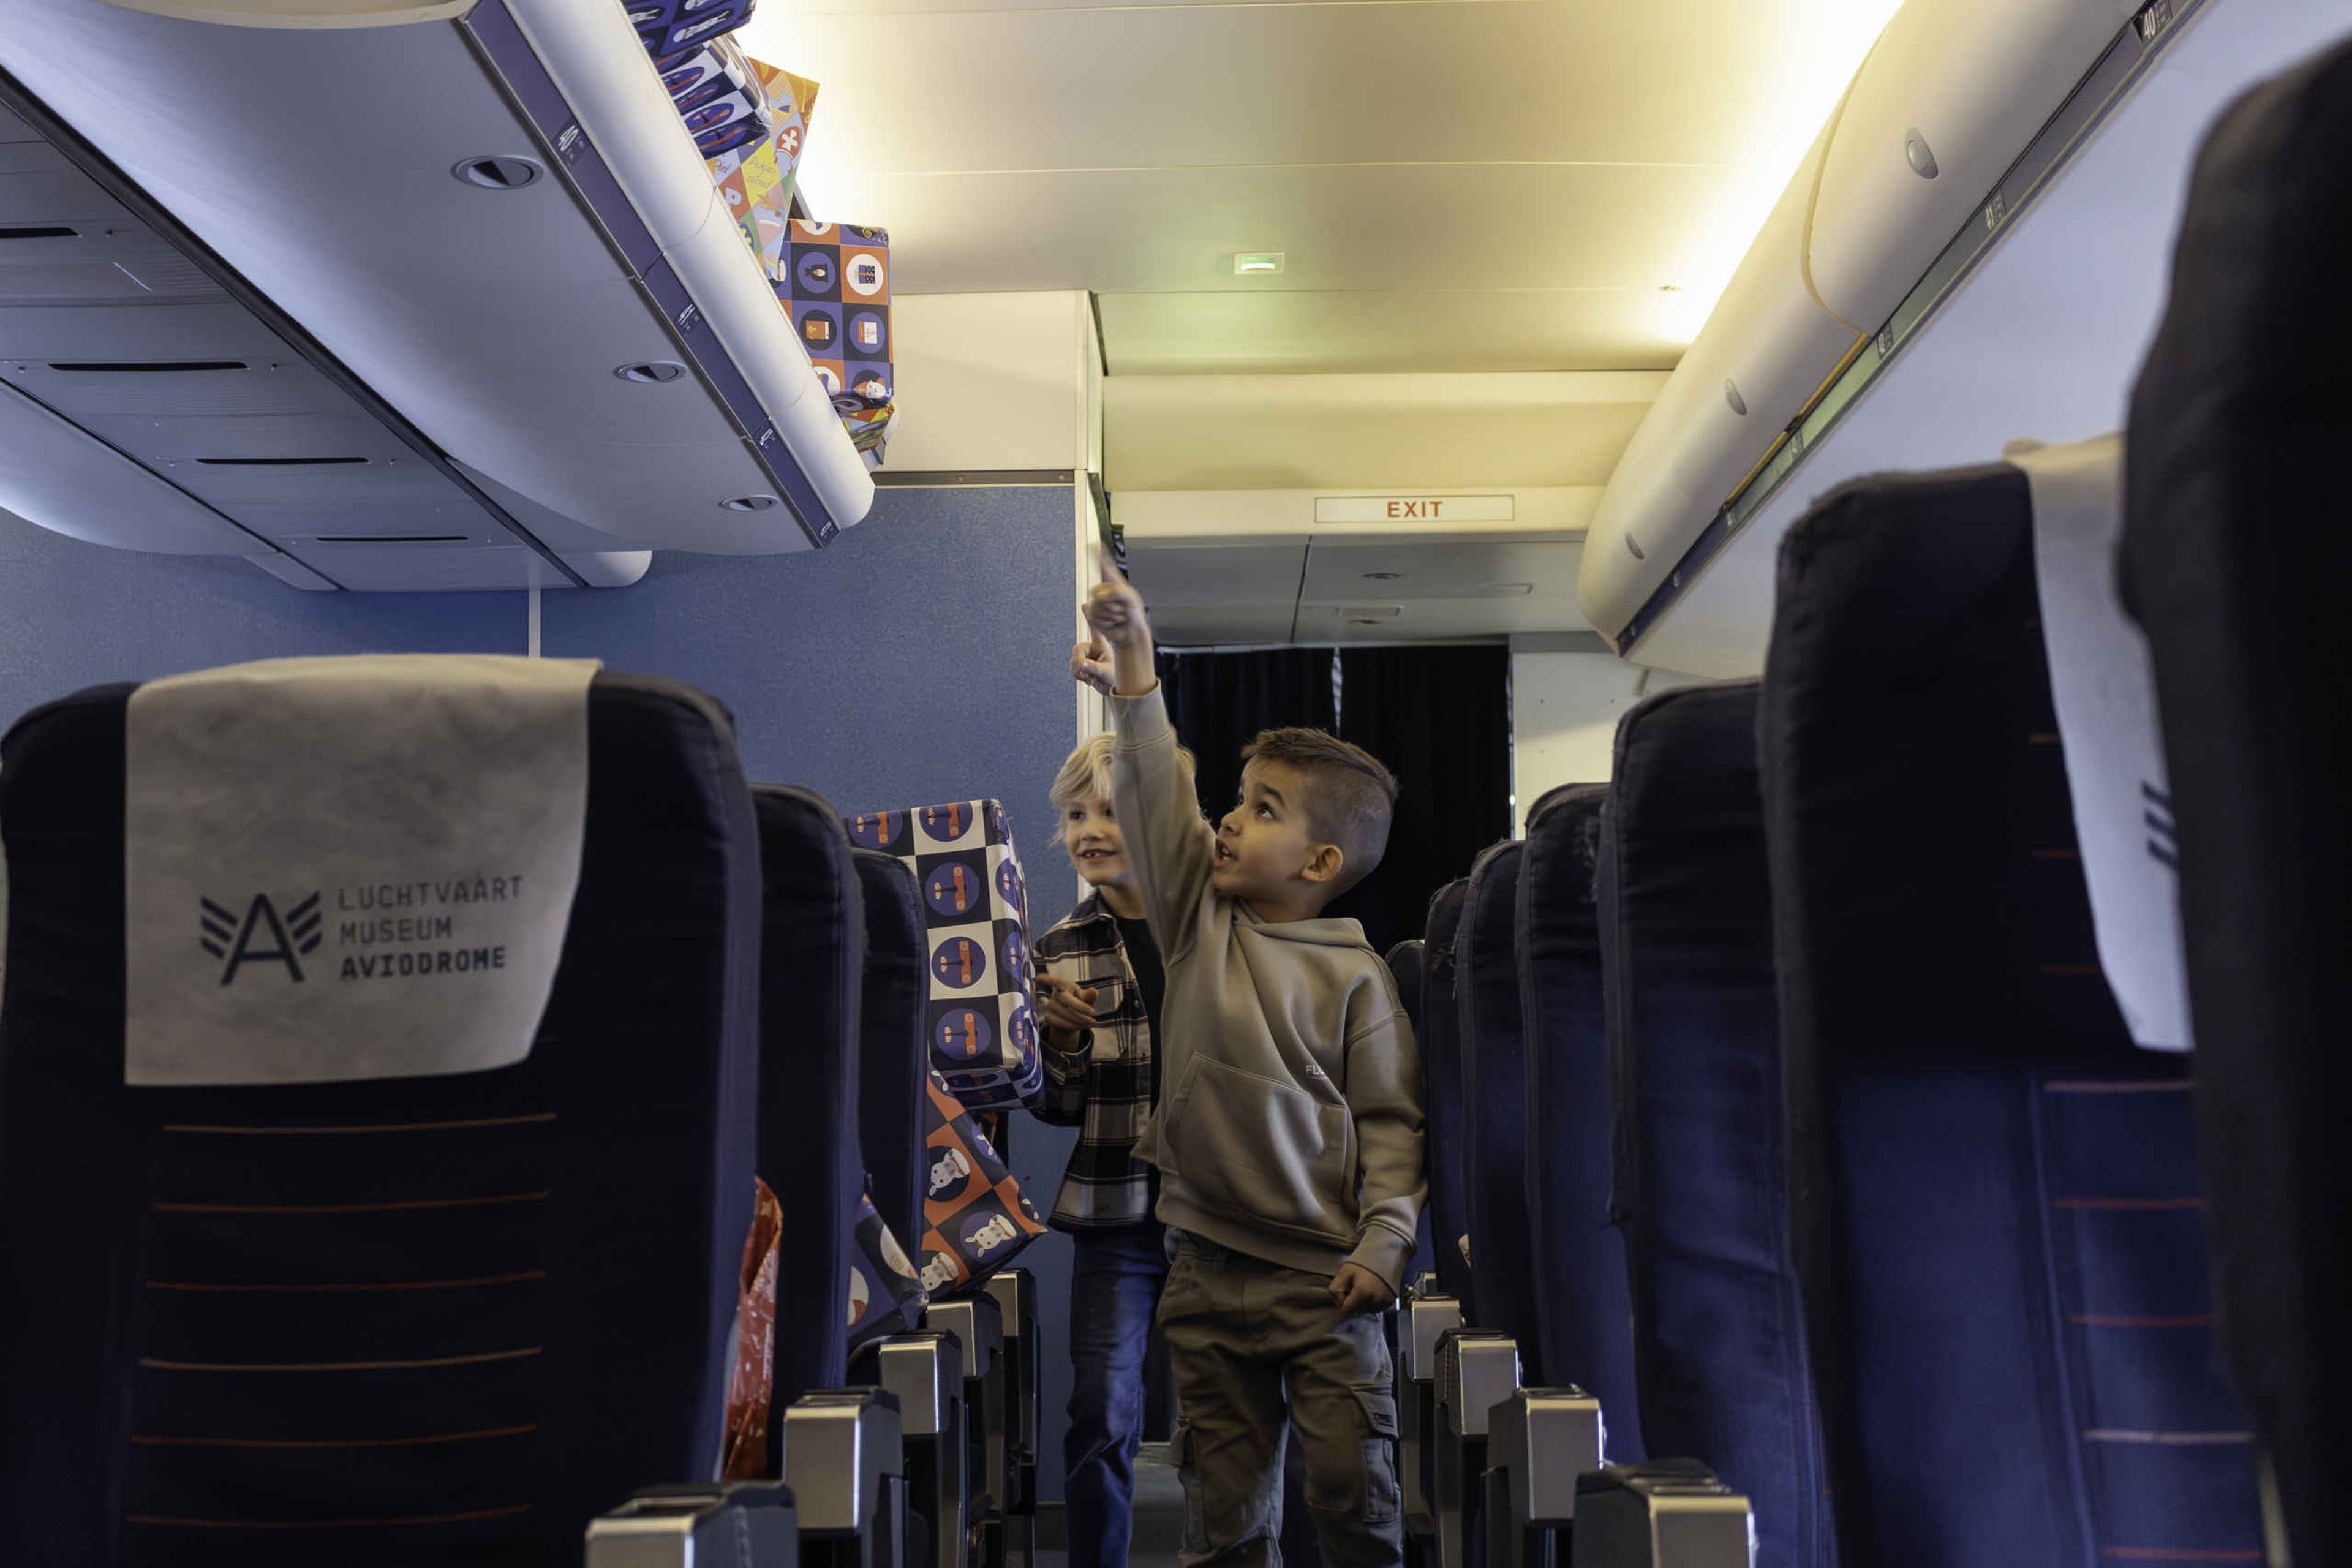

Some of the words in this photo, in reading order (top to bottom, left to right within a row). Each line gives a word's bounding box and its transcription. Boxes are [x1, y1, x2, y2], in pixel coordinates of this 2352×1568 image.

[2144, 7, 2156, 40] 40
[1387, 501, 1443, 517] EXIT
[339, 876, 522, 911] LUCHTVAART
[339, 917, 452, 944] MUSEUM
[341, 947, 506, 978] AVIODROME
